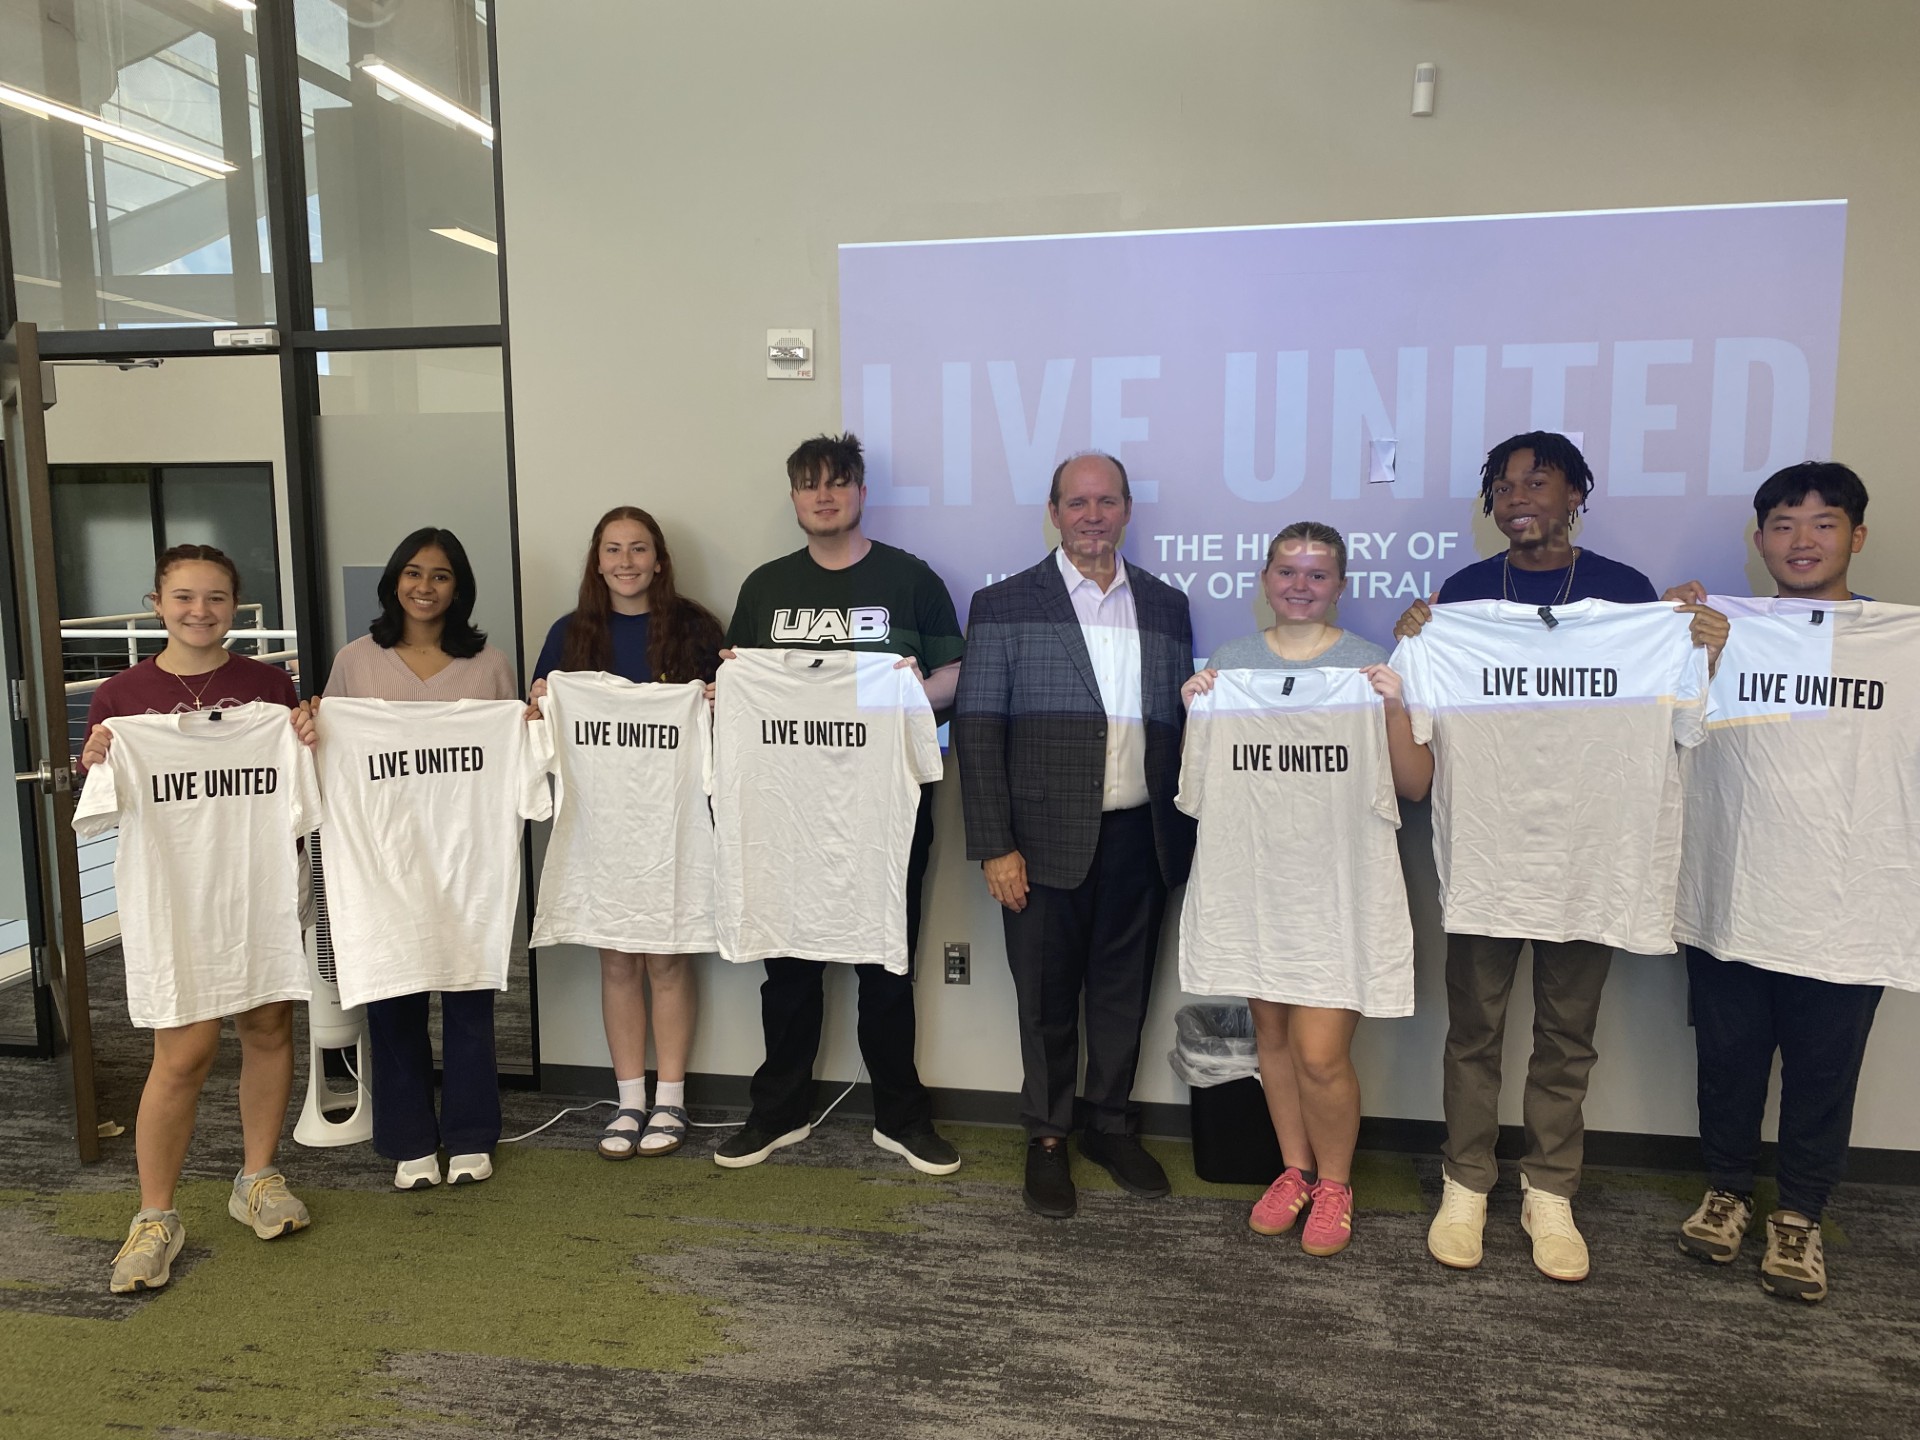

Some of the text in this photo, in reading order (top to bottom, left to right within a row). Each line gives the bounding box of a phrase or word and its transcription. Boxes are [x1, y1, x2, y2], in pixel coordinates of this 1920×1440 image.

[863, 336, 1811, 506] LIVE UNITED
[1154, 534, 1223, 562] THE
[1236, 532, 1398, 560] HIRY
[1407, 531, 1459, 560] OF
[1207, 571, 1256, 599] OF
[771, 606, 890, 644] UAB
[1484, 667, 1618, 697] LIVE UNITED
[1738, 672, 1884, 710] LIVE UNITED
[575, 720, 679, 750] LIVE UNITED
[762, 719, 867, 748] LIVE UNITED
[368, 746, 484, 781] LIVE UNITED
[1232, 744, 1349, 773] LIVE UNITED
[152, 767, 278, 803] LIVE UNITED
